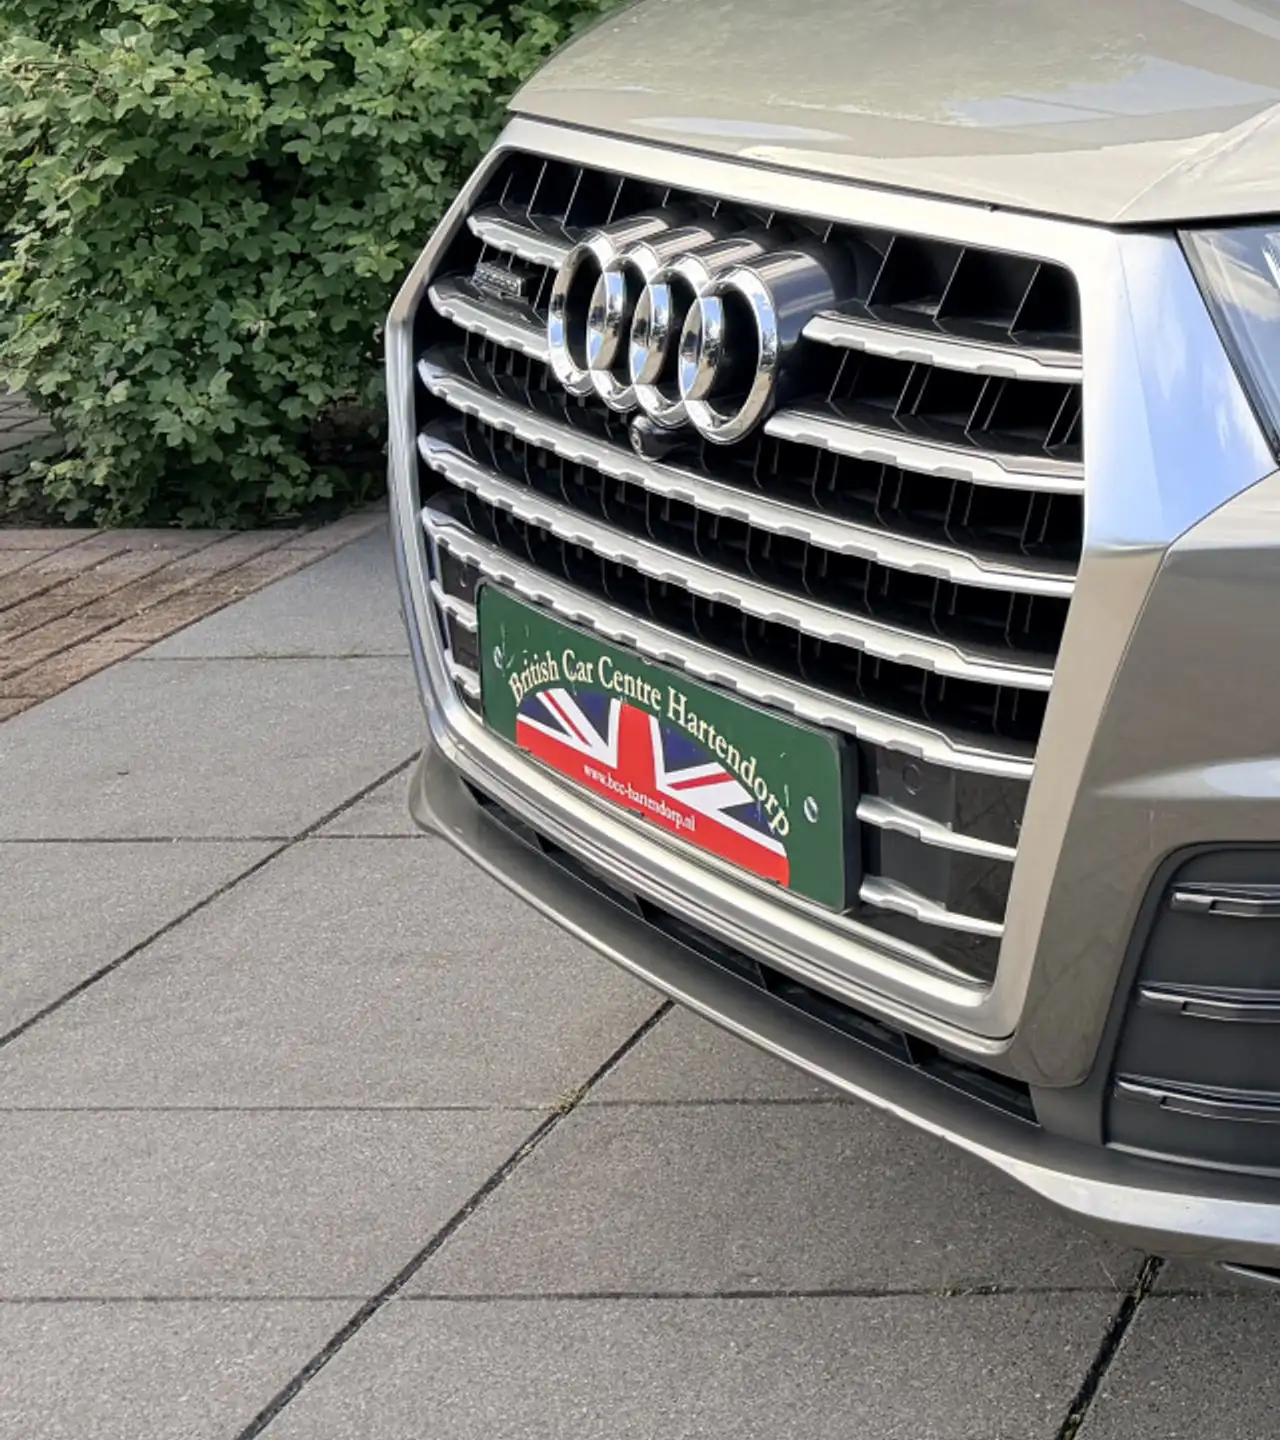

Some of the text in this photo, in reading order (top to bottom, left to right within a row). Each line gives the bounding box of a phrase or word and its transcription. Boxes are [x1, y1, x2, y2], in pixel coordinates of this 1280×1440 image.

[508, 648, 790, 836] British Car Centre Hartendorp
